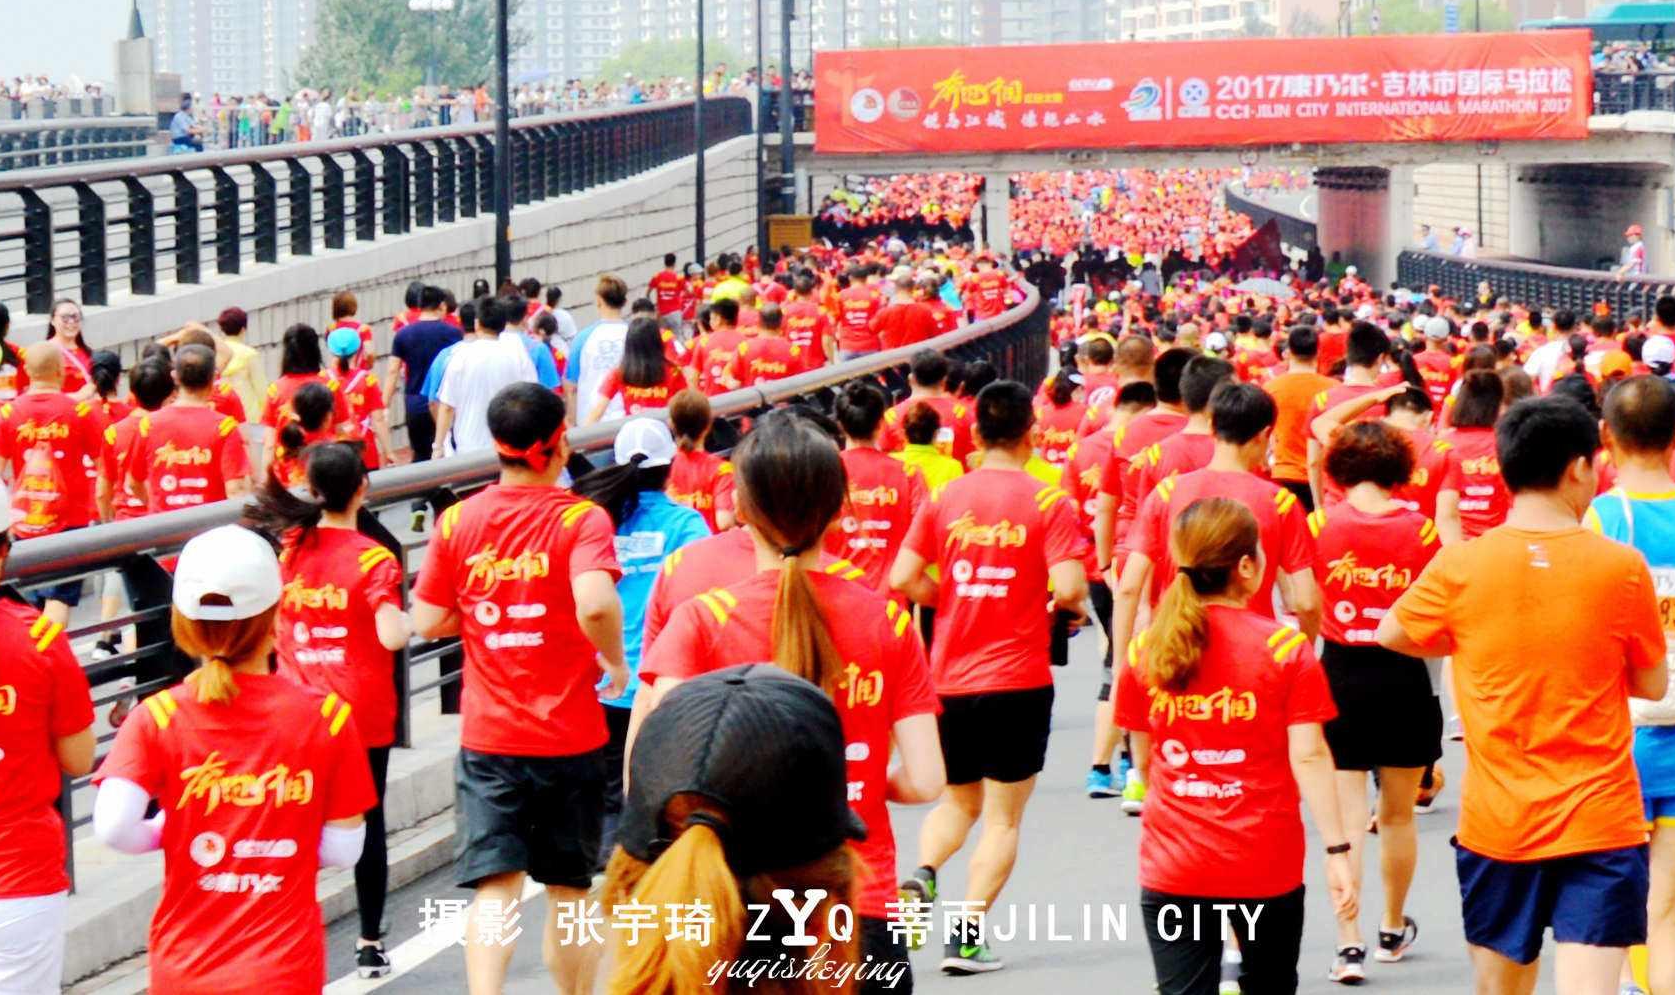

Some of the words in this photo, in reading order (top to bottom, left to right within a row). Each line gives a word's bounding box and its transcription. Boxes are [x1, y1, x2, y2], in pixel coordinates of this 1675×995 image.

[1296, 103, 1330, 118] CITY
[1336, 99, 1451, 117] INTERNATIONAL
[1457, 98, 1538, 115] MARATHON
